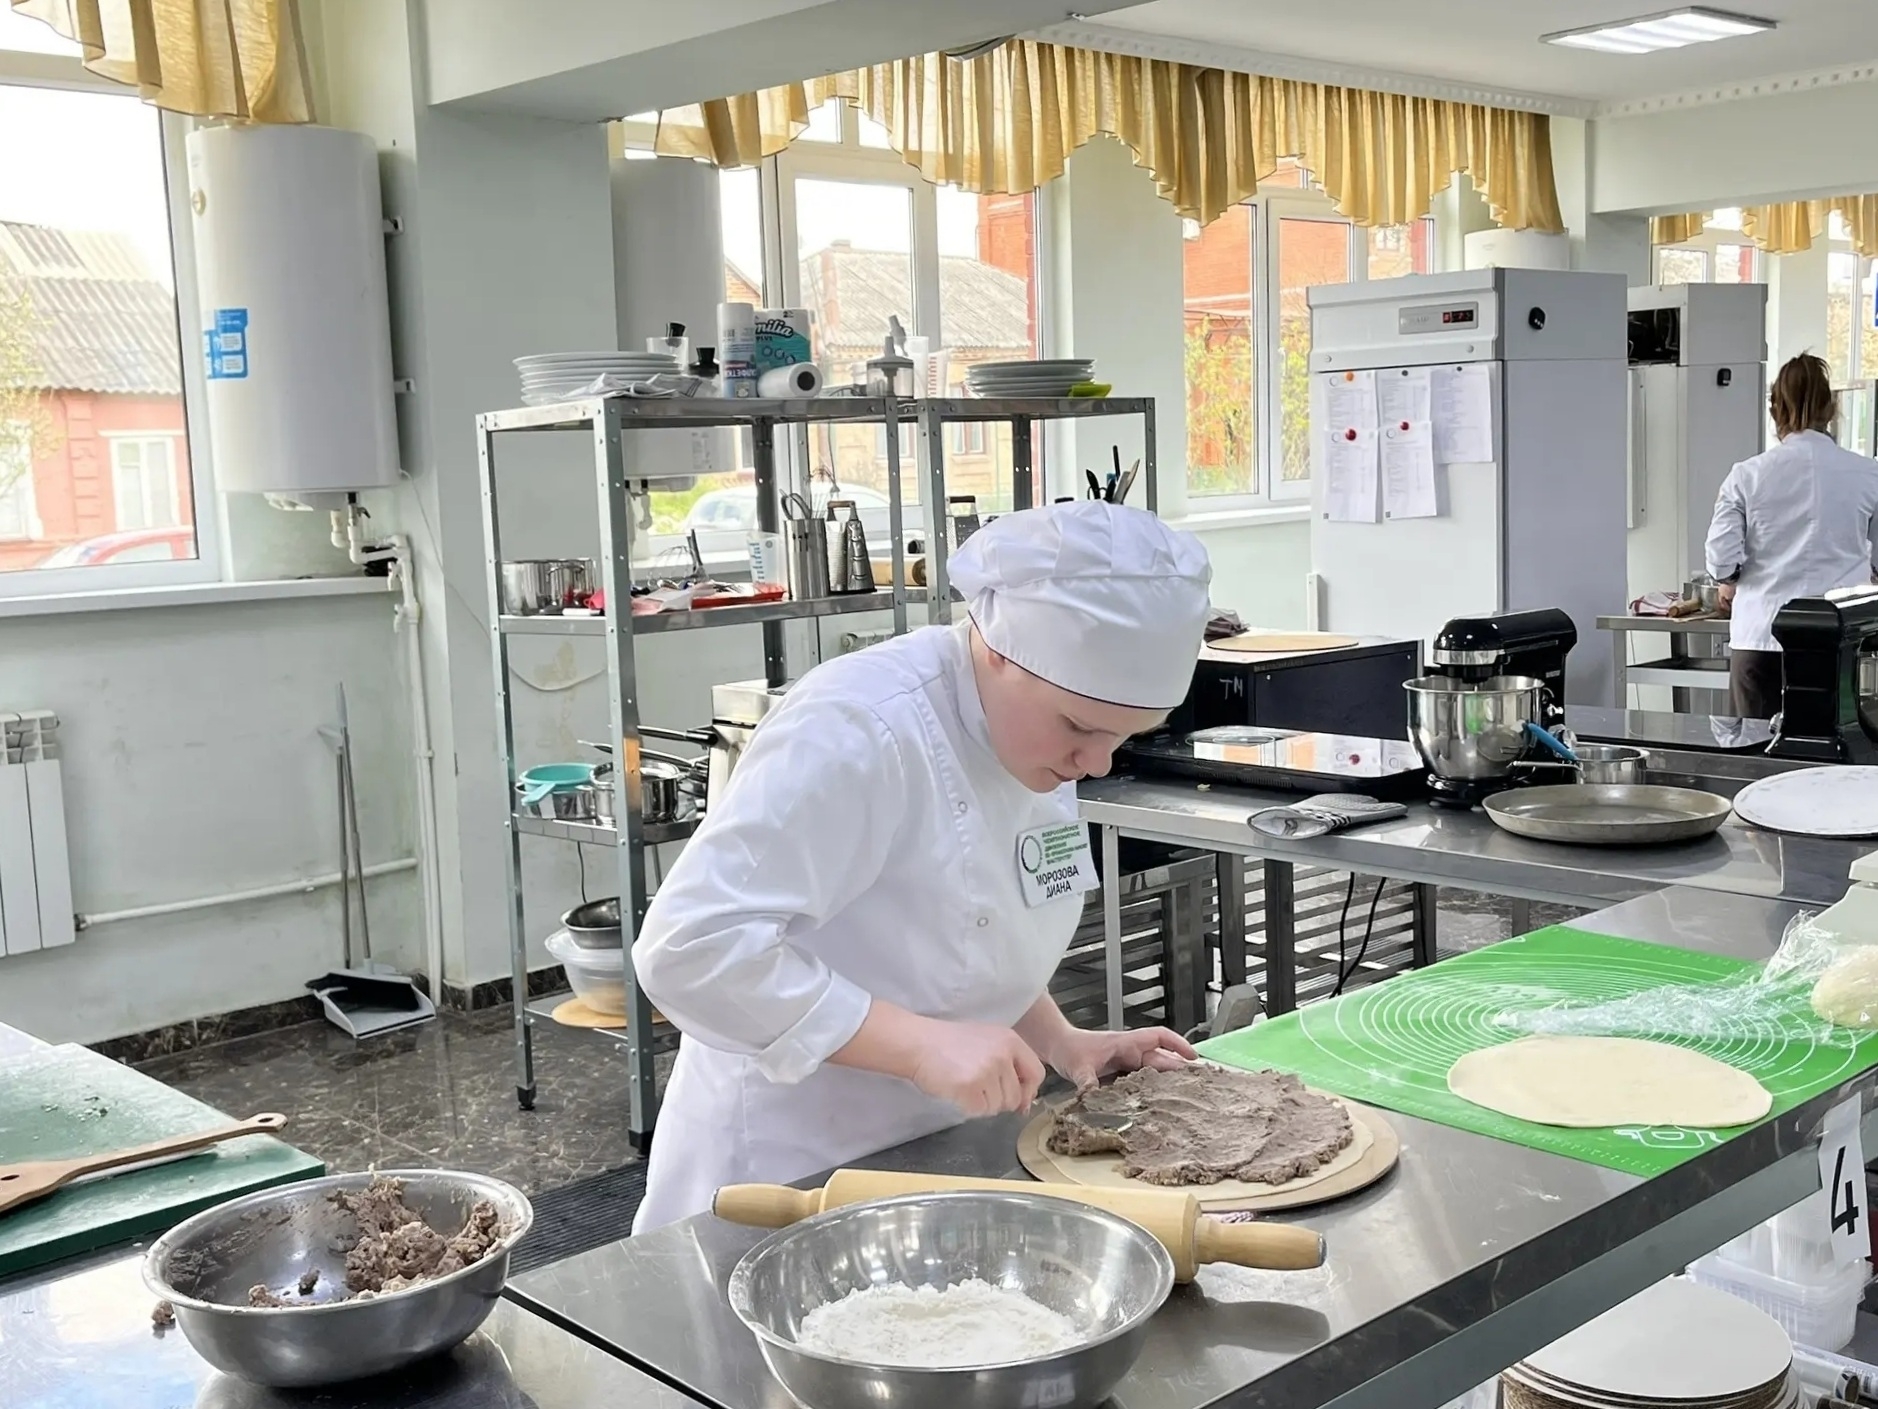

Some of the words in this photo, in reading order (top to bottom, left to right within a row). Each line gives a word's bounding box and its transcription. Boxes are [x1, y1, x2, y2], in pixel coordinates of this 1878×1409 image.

[1036, 865, 1080, 886] МОРОЗОВА
[1046, 881, 1072, 899] ДИАНА
[1831, 1145, 1859, 1236] 4
